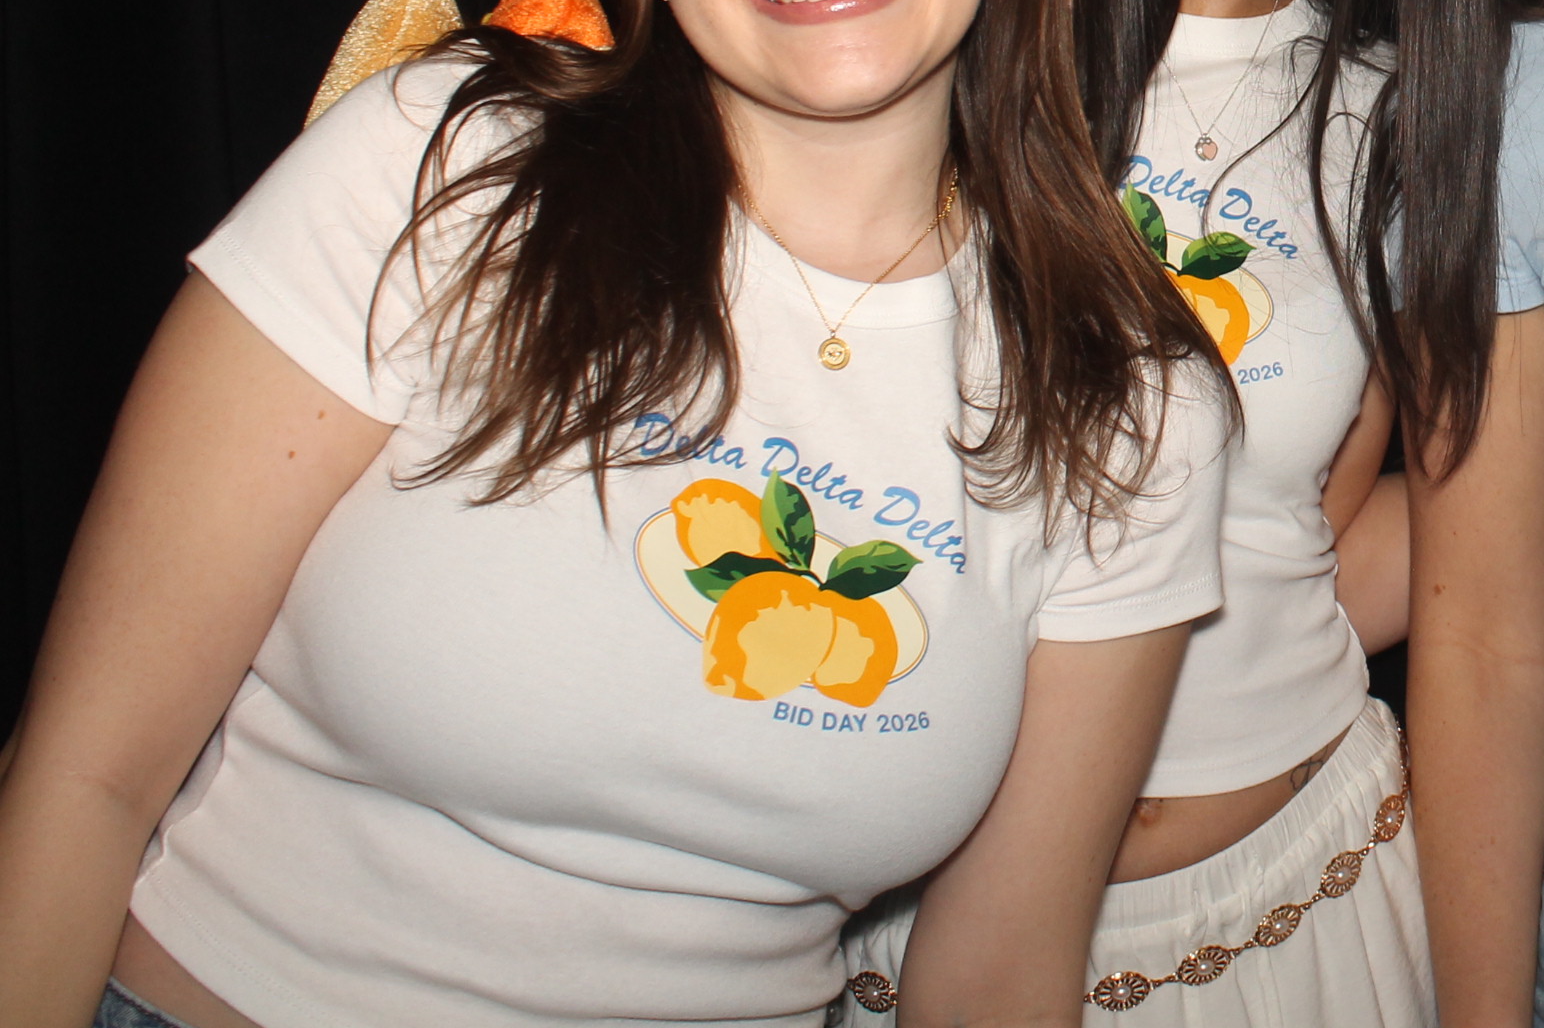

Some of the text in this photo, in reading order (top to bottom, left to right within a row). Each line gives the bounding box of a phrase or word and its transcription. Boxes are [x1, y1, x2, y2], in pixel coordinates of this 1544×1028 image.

[1120, 155, 1298, 259] Delta Delta
[1238, 362, 1284, 385] 2026
[761, 437, 864, 510] Delta
[873, 486, 967, 574] Delta
[773, 701, 930, 733] BID DAY 2026
